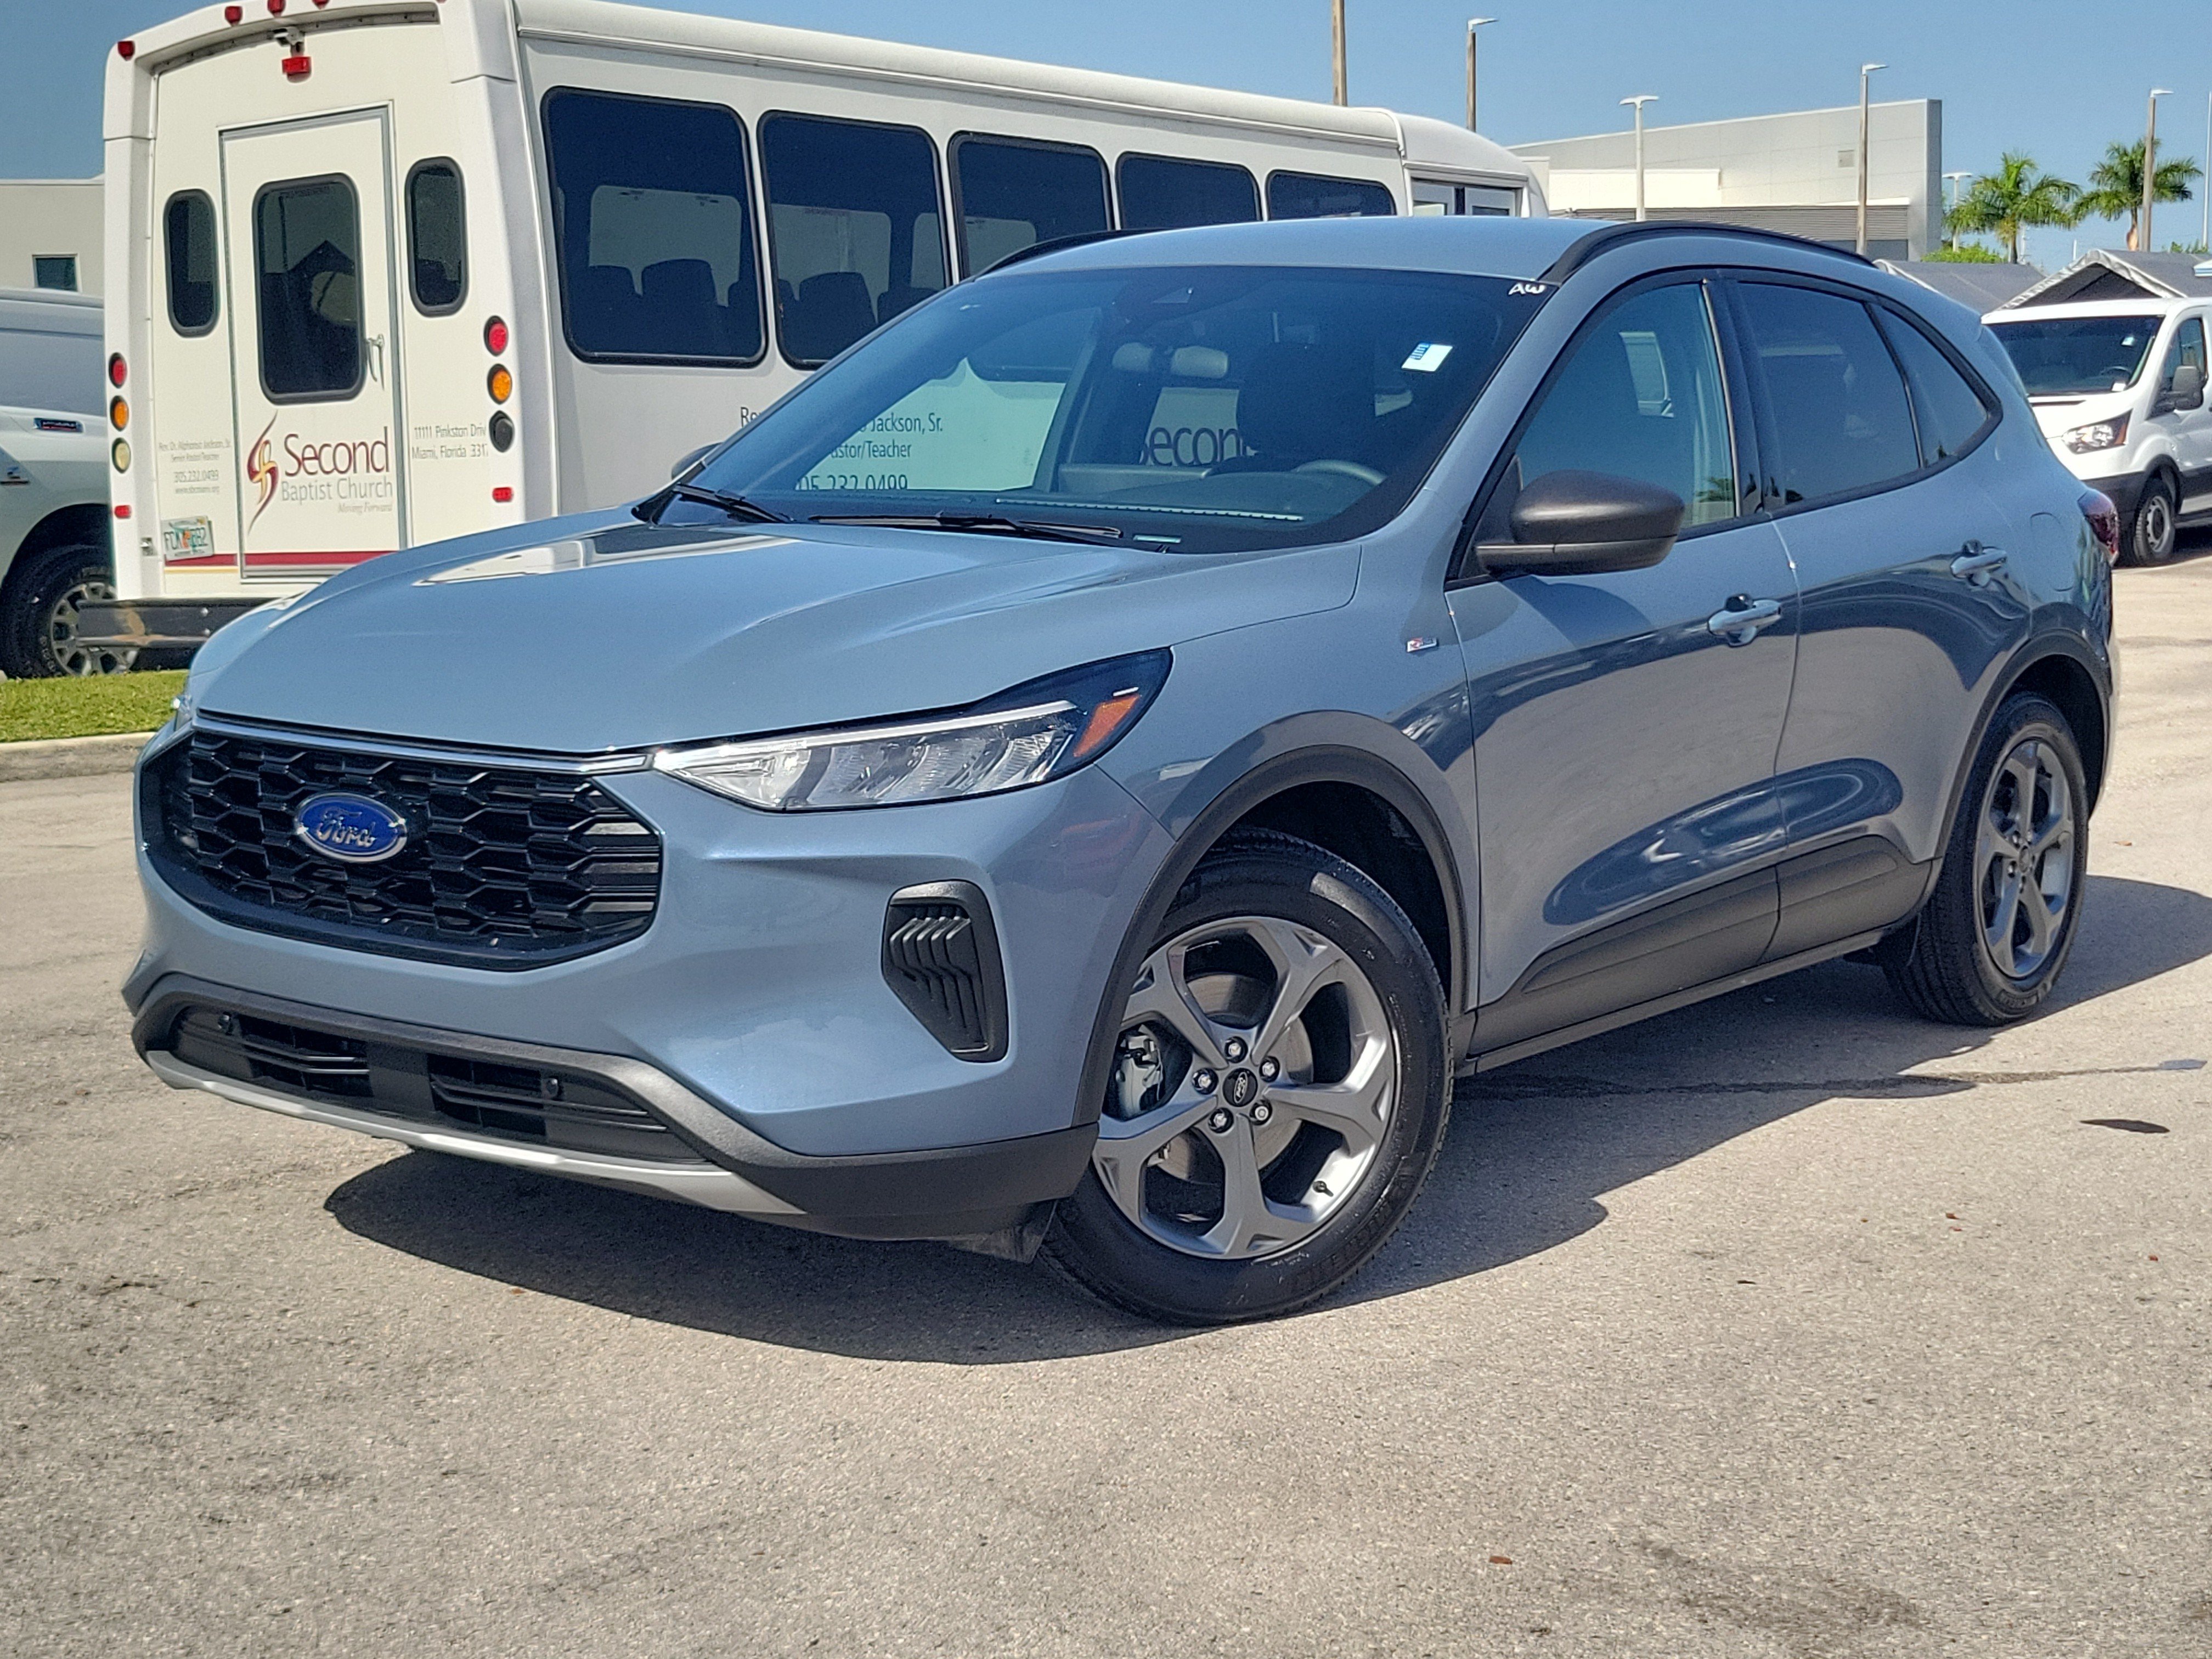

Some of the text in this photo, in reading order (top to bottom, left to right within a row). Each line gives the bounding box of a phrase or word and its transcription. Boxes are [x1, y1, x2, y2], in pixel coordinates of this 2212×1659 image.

[470, 422, 486, 437] Driv
[871, 412, 925, 435] Jackson,
[928, 412, 943, 432] Sr.
[284, 426, 390, 477] Second
[412, 445, 438, 459] Miami,
[441, 444, 466, 458] Florida
[830, 439, 912, 460] astor/Teacher
[1139, 427, 1245, 467] econ
[281, 476, 393, 505] Baptist Church
[316, 806, 377, 848] Ford
